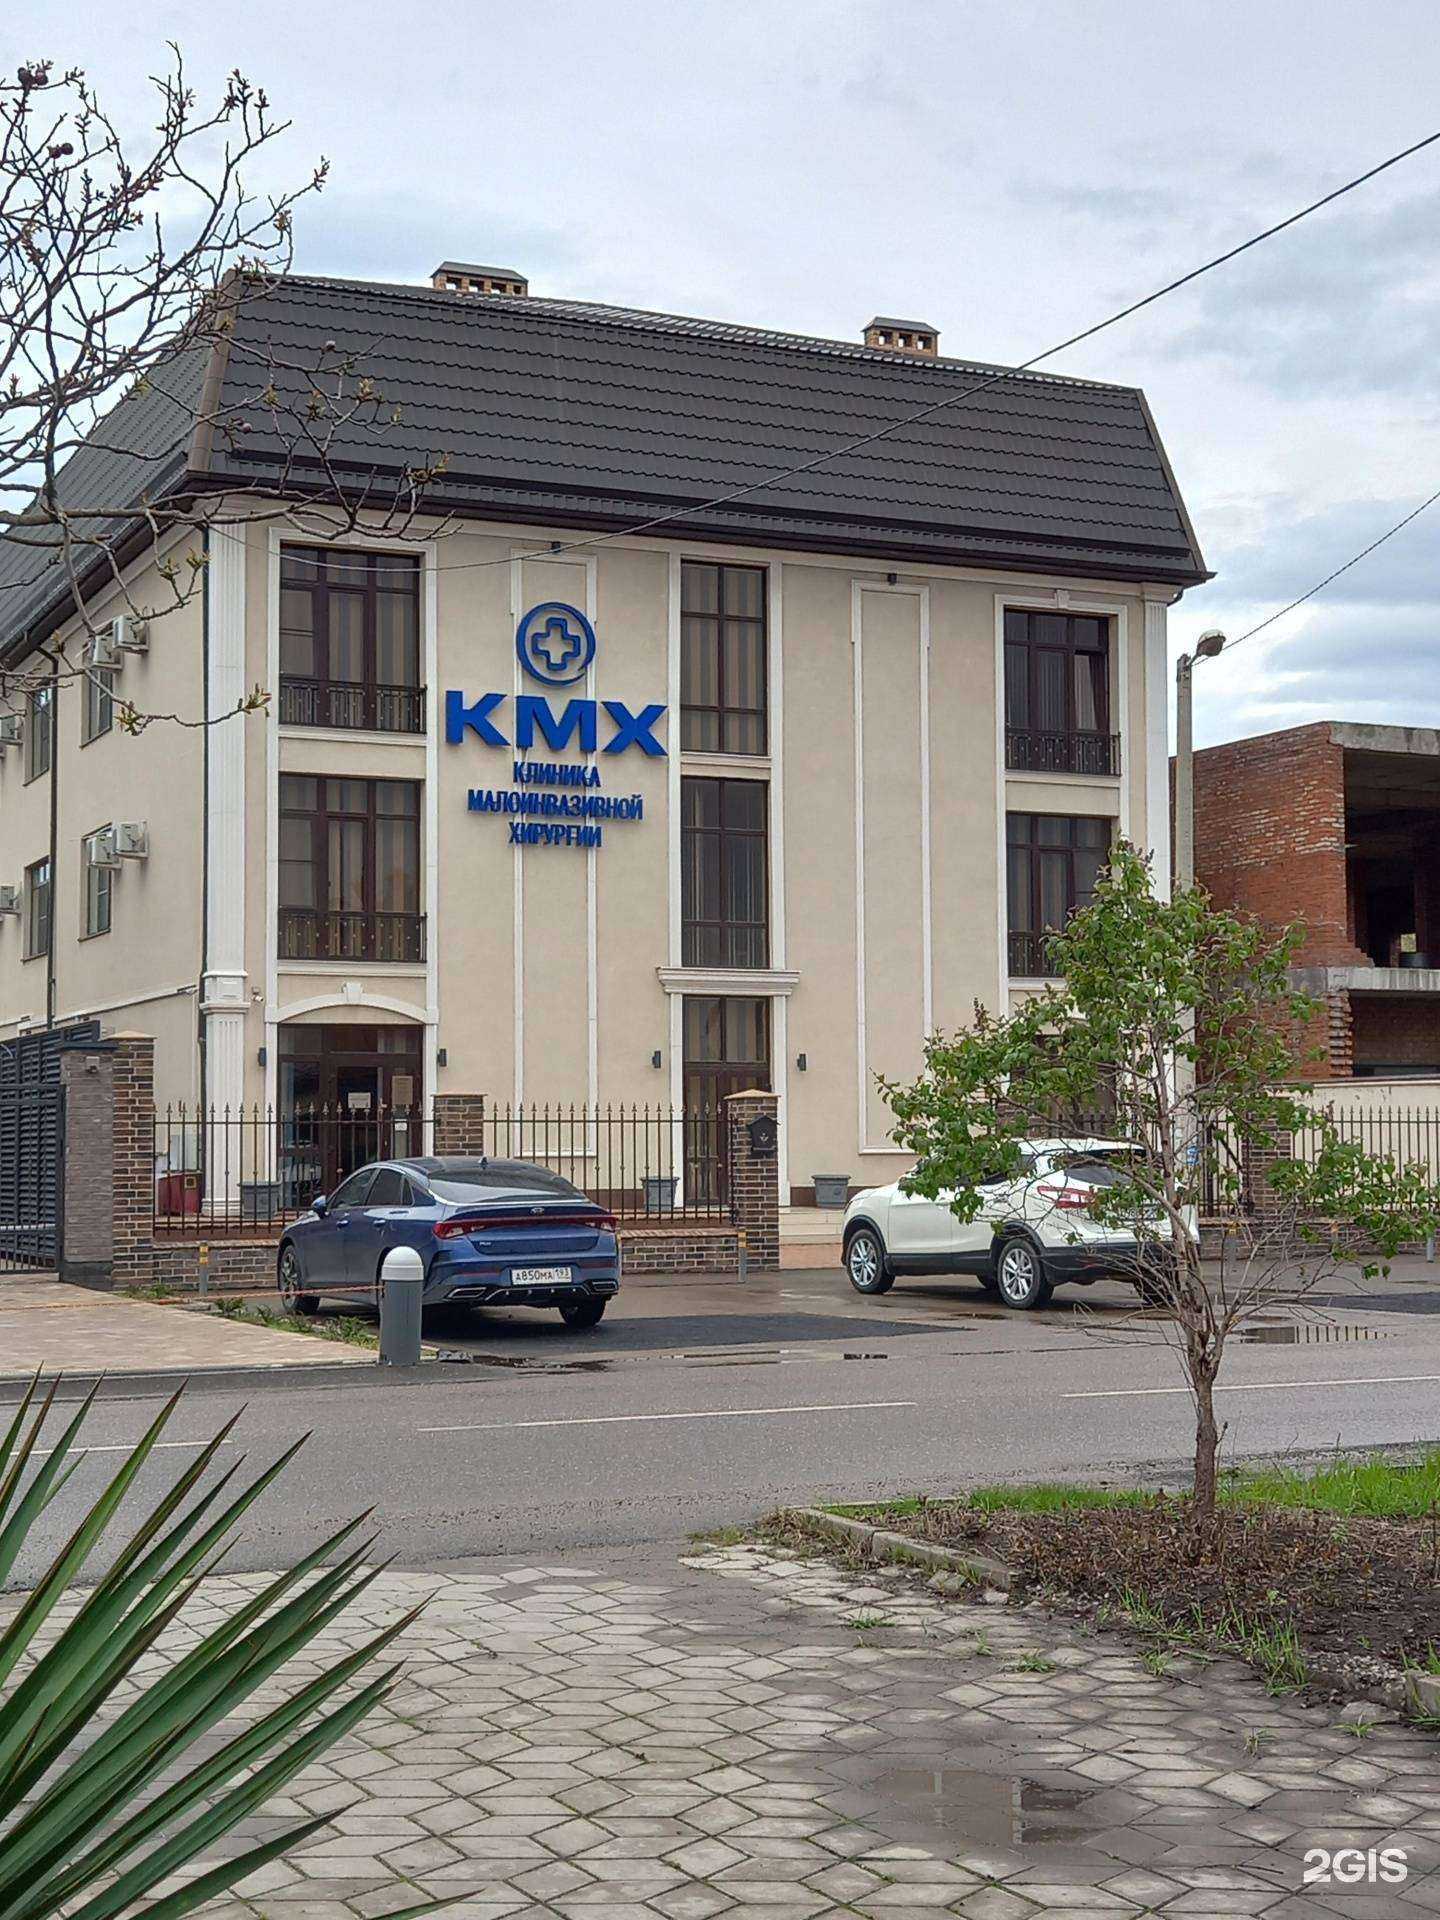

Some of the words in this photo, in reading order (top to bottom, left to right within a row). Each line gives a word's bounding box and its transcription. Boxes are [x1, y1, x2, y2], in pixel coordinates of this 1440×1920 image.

[446, 690, 668, 757] КМХ
[513, 761, 601, 788] КЛИНИКА
[467, 789, 643, 820] МАЛОИНВАЗИВНОЙ
[508, 822, 602, 848] ХИРУРГИИ
